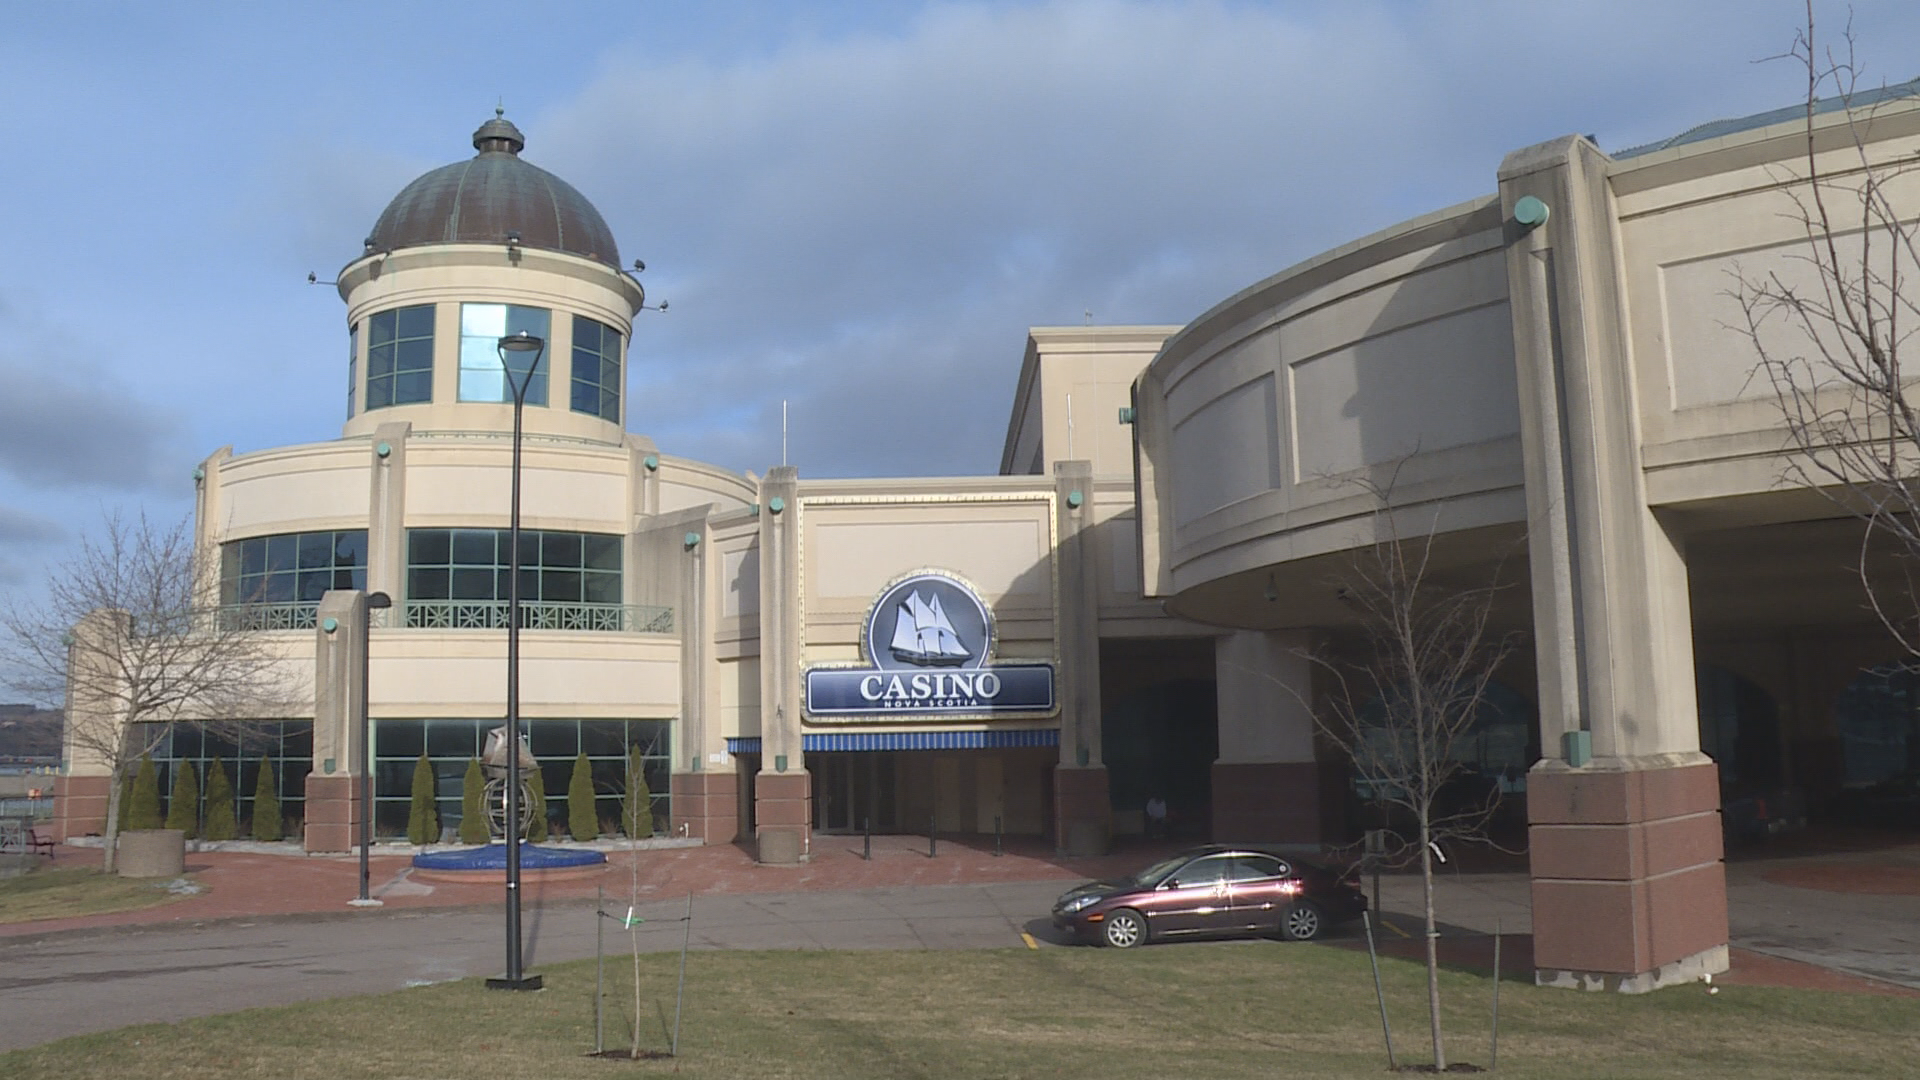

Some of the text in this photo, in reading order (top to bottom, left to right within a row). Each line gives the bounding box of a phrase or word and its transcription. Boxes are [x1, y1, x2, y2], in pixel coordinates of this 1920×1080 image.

[860, 672, 1001, 701] CASINO
[884, 699, 978, 708] NOVA SCOTIA
